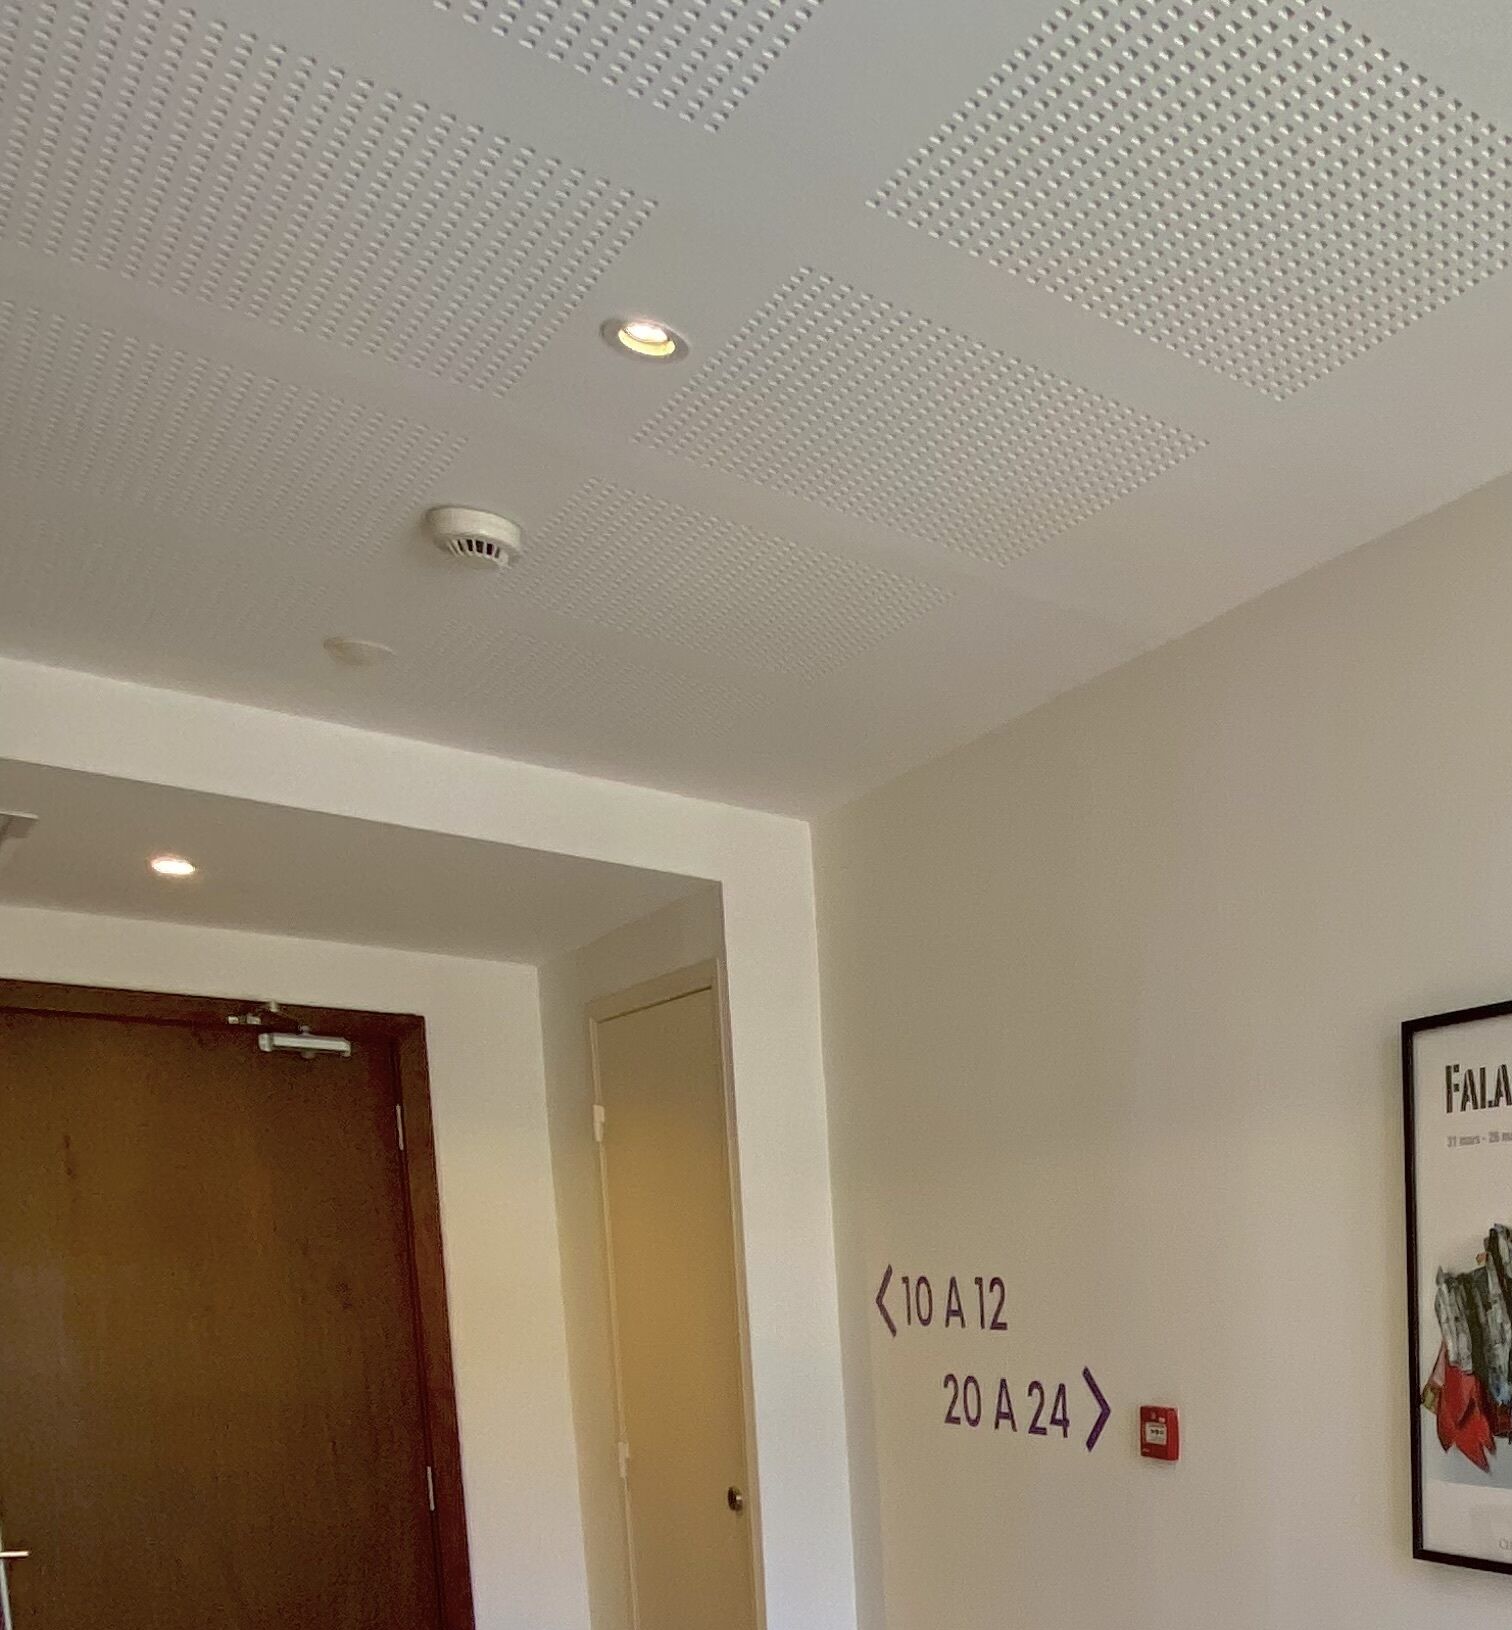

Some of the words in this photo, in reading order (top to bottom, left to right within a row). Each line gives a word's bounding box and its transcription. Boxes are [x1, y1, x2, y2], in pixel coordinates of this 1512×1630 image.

[902, 1275, 934, 1327] 10
[944, 1275, 966, 1329] A
[974, 1276, 1008, 1331] 12
[943, 1373, 982, 1428] 20
[993, 1377, 1018, 1432] A
[1027, 1380, 1071, 1438] 24
